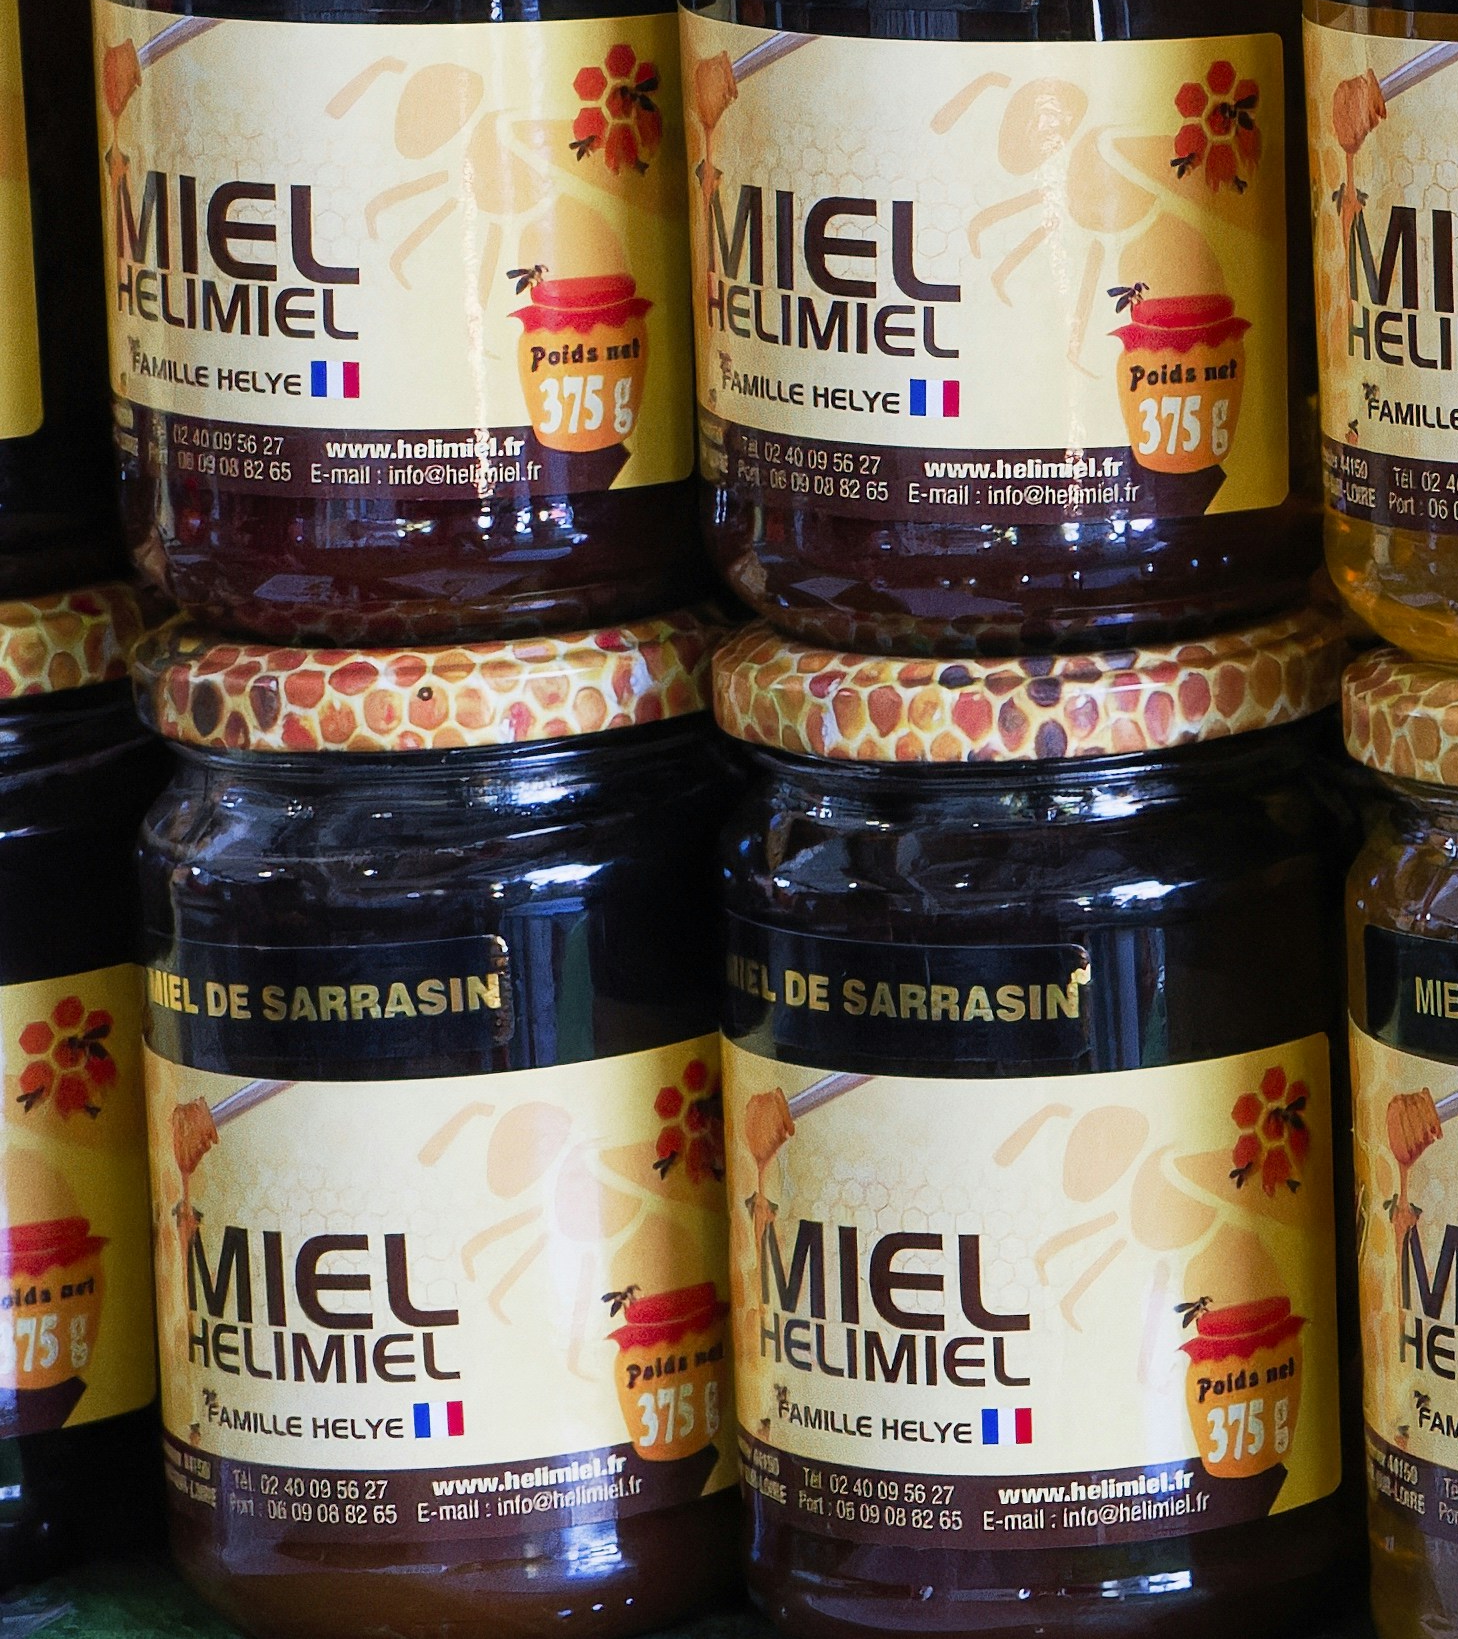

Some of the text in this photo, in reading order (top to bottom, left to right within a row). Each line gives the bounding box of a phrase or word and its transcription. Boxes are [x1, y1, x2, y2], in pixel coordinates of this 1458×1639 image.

[116, 170, 359, 284] MIEL
[708, 185, 961, 301] MIEL
[118, 268, 358, 340] HELIMIEL
[708, 280, 959, 359] HELIMIEL
[532, 342, 600, 372] Poids
[539, 378, 600, 434] 375
[326, 437, 524, 459] www.helimiel.fr
[206, 981, 251, 1019] DE
[263, 973, 502, 1021] SARRASIN
[785, 970, 829, 1011] DE
[843, 979, 1080, 1022] SARRASIN
[188, 1225, 459, 1329] MIEL
[761, 1219, 1031, 1331] MIEL
[189, 1324, 461, 1383] HELIMIEL
[760, 1312, 1031, 1387] HELIMIEL
[207, 1403, 403, 1439] FAMILLE HELYE
